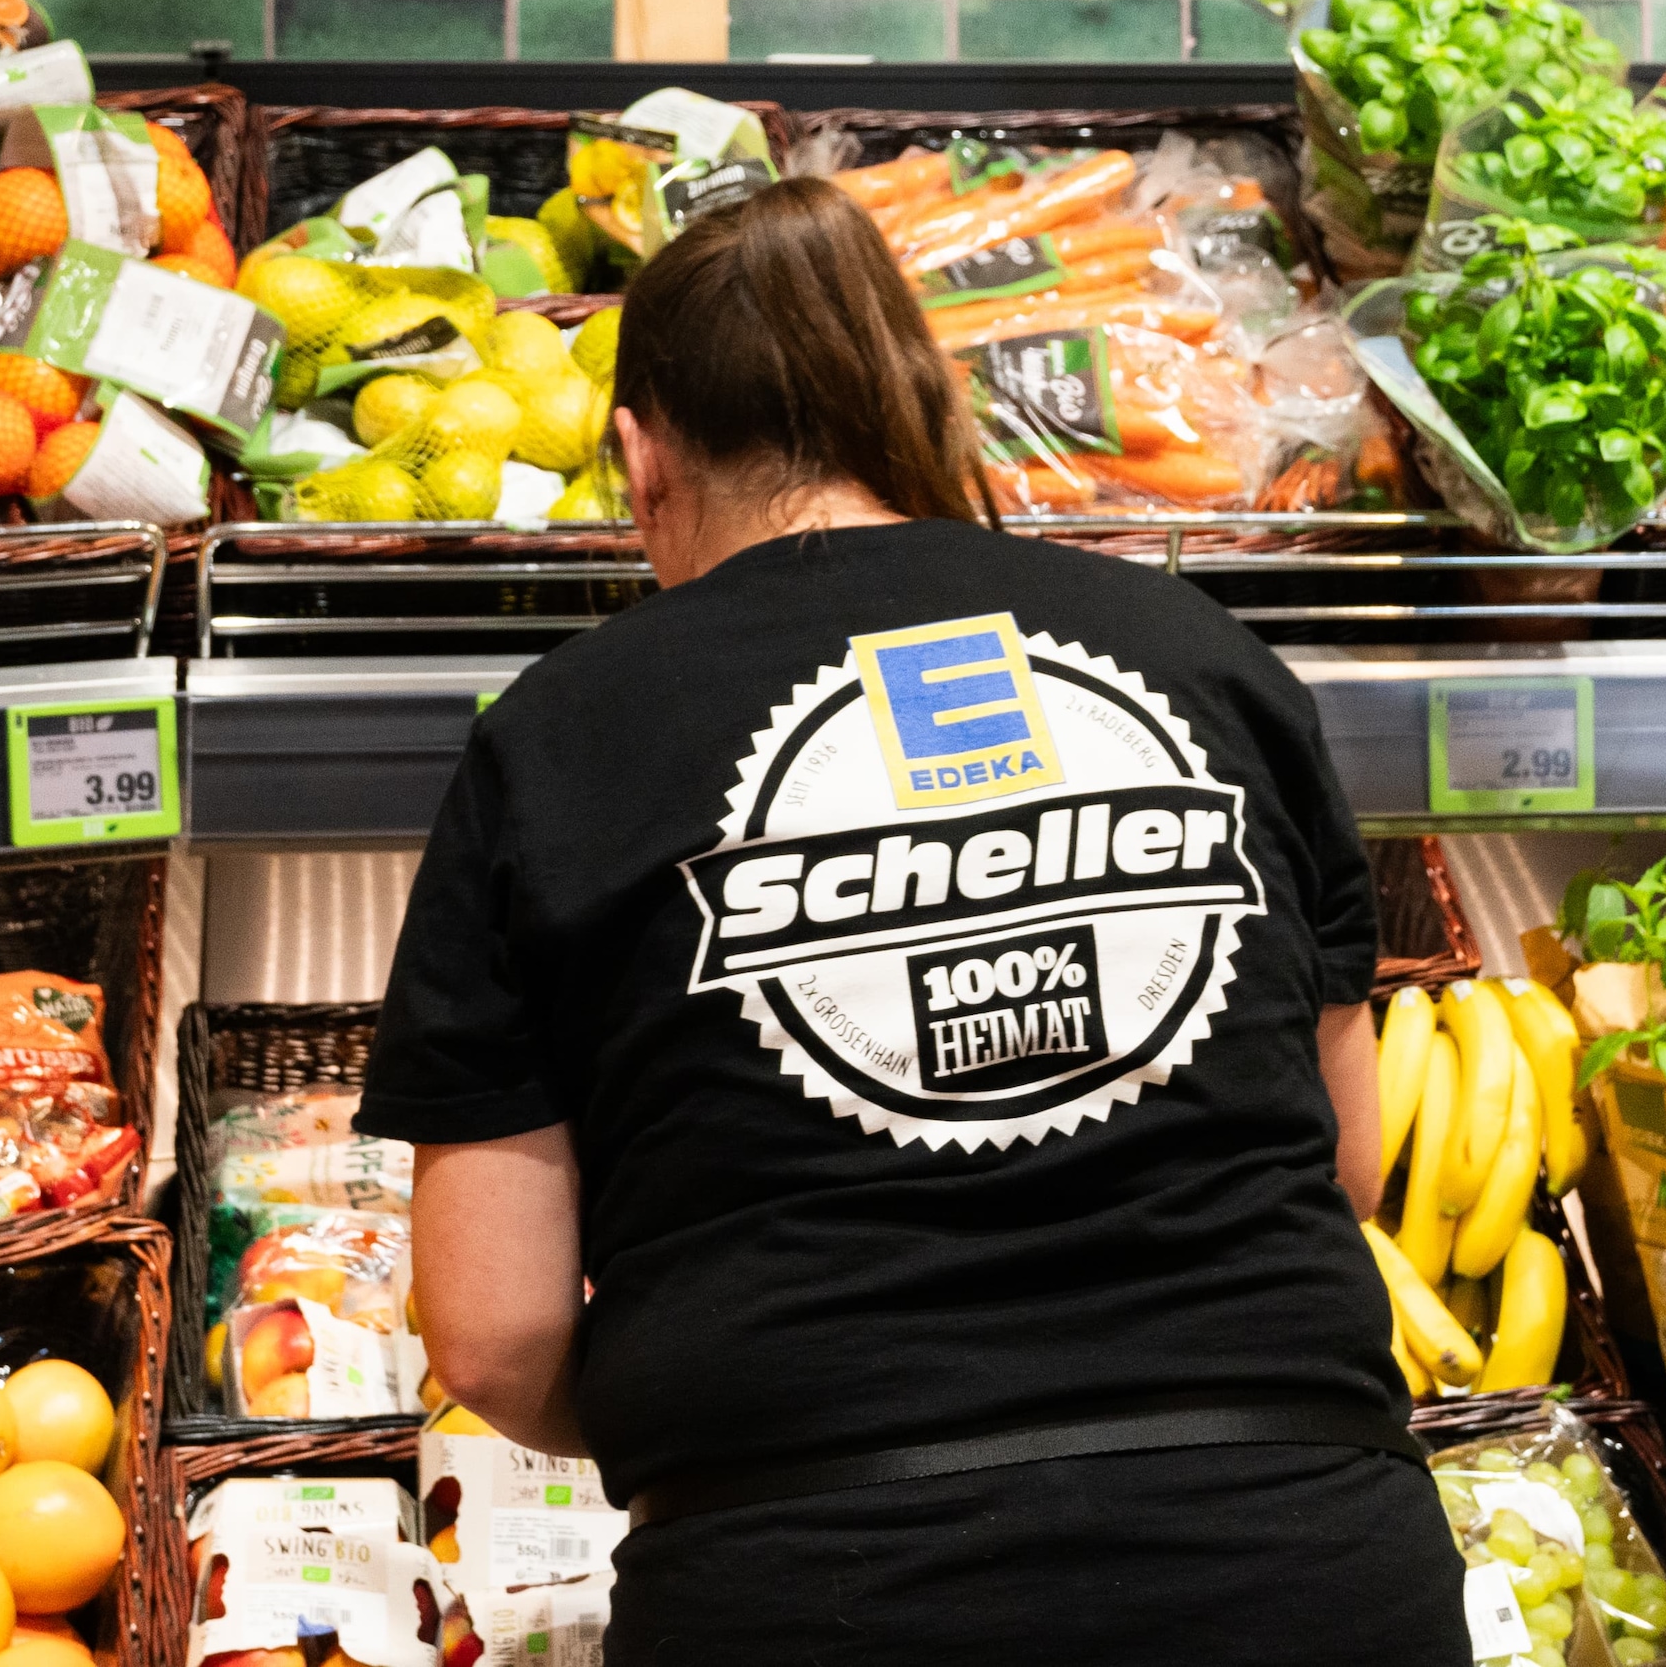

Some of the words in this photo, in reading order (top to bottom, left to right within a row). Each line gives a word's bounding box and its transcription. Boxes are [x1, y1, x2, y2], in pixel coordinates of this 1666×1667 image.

[1087, 705, 1161, 768] RADEBERG
[1501, 748, 1571, 778] 2.99
[86, 771, 155, 804] 3.99
[785, 781, 810, 807] SEIT
[803, 741, 838, 775] 1936
[909, 750, 1045, 792] EDEKA
[719, 803, 1227, 938] Scheller
[923, 943, 1087, 1011] 100%
[1137, 937, 1188, 1012] DRESDEN
[814, 996, 913, 1078] GROSSENHAIN
[930, 996, 1090, 1079] HEIMAT
[264, 1536, 328, 1558] SWING
[335, 1538, 372, 1563] BIO
